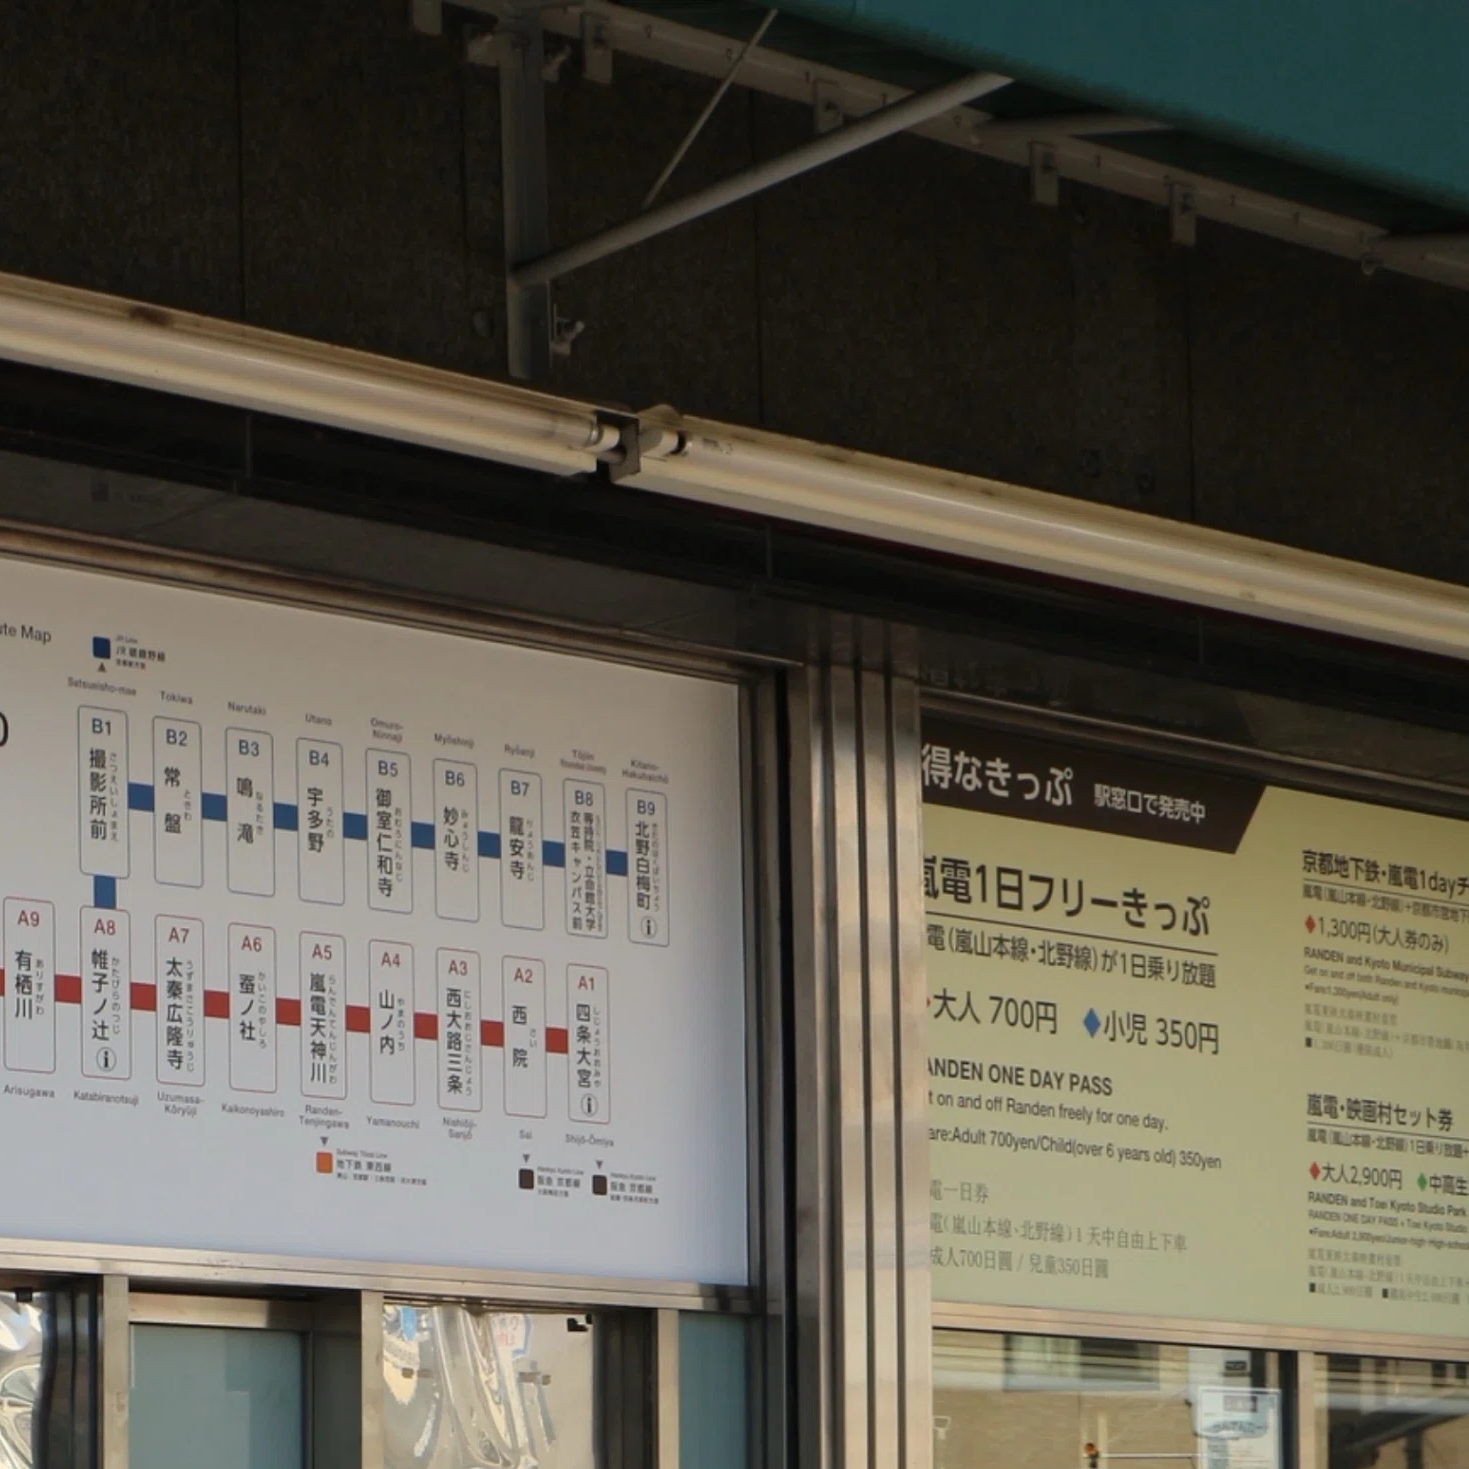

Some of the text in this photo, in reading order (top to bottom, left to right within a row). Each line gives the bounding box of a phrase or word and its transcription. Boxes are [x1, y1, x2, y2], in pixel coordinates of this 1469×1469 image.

[21, 625, 51, 644] Map
[160, 690, 193, 705] Tokiwa
[228, 702, 266, 716] Narutaki
[92, 718, 111, 736] B1
[166, 729, 188, 747] B2
[239, 739, 259, 757] B3
[309, 751, 329, 767] B4
[378, 760, 398, 777] B5
[445, 771, 465, 787] B6
[90, 747, 107, 841] 撮影所前
[511, 781, 529, 797] B7
[575, 791, 594, 806] B8
[164, 767, 181, 834] 常盤
[637, 800, 655, 815] B9
[1094, 784, 1206, 824] 駅窓口で発売中
[237, 777, 254, 844] 鳴滝
[307, 788, 324, 853] 宇多野
[376, 788, 393, 898] 御室仁和寺
[444, 806, 459, 872] 妙心寺
[635, 821, 650, 910] 北野白梅町
[17, 910, 40, 927] A9
[94, 919, 116, 936] A8
[169, 927, 189, 944] A7
[242, 936, 262, 952] A6
[312, 944, 332, 960] A5
[381, 952, 401, 968] A4
[449, 960, 467, 976] A3
[1304, 947, 1434, 978] RANDEN and Kyoto Municipal
[15, 950, 32, 1020] 有栖川
[514, 968, 533, 984] A2
[578, 976, 595, 991] A1
[166, 958, 183, 1070] 太秦広隆寺
[239, 974, 256, 1041] 蚕ノ社
[310, 973, 327, 1084] 嵐電天神川
[379, 990, 395, 1055] 山ノ内
[934, 988, 1219, 1055] 大人 700円 小児 350円
[446, 988, 463, 1095] 西大路三条
[512, 1006, 528, 1068] 西院
[576, 1004, 592, 1089] 四条大宮
[989, 1064, 1112, 1096] ONE DAY PASS
[4, 1085, 55, 1098] Arisugawa
[305, 1104, 343, 1116] Randen-
[937, 1094, 954, 1107] on
[958, 1092, 982, 1110] and
[986, 1097, 1003, 1112] off
[1007, 1099, 1055, 1118] Randen
[1059, 1105, 1092, 1125] freely
[1096, 1108, 1113, 1123] for
[1117, 1111, 1139, 1127] one
[1144, 1113, 1168, 1133] day.
[1307, 1094, 1453, 1132] 嵐電・映画村セット券
[299, 1115, 349, 1129] Tenjingawa
[367, 1116, 420, 1129] Yamanouchi
[1106, 1144, 1114, 1158] 6
[1118, 1147, 1150, 1163] years
[1154, 1149, 1176, 1167] old)
[1180, 1150, 1221, 1171] 350yen
[1322, 1163, 1403, 1190] 大人2,900円
[1308, 1192, 1348, 1206] RANDEN
[1350, 1196, 1367, 1208] and
[1390, 1201, 1415, 1214] Kyoto
[1418, 1202, 1445, 1215] Studio
